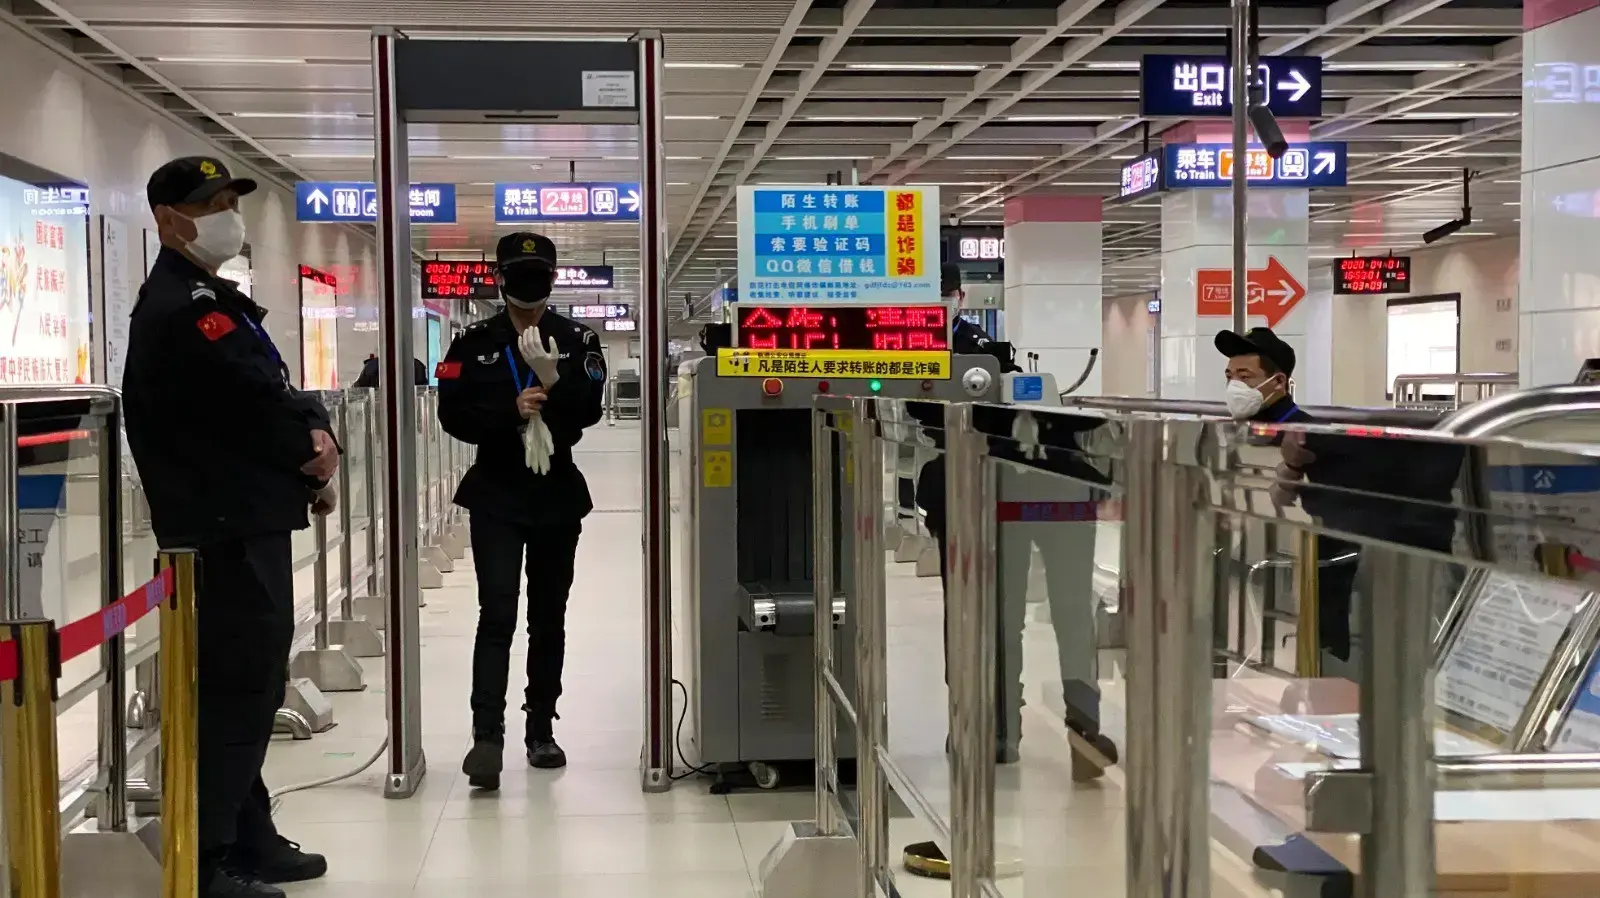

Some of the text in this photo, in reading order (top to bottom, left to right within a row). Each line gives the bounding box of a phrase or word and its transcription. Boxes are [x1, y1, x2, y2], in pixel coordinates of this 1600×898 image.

[1174, 64, 1225, 91] 出口
[1193, 93, 1223, 106] Exit
[1177, 149, 1215, 169] 乘车
[1175, 170, 1188, 179] To
[1190, 170, 1215, 180] Train
[505, 189, 537, 205] 乘车
[781, 193, 859, 209] 陌生转账
[503, 207, 514, 215] To
[515, 206, 538, 215] Train
[781, 215, 859, 230] 手机刷单
[896, 193, 916, 276] 都是诈骗
[771, 237, 870, 252] 索要验证码
[766, 258, 875, 274] QQ微信借钱
[758, 359, 941, 376] 凡是陌生人要求转账的都是诈骗
